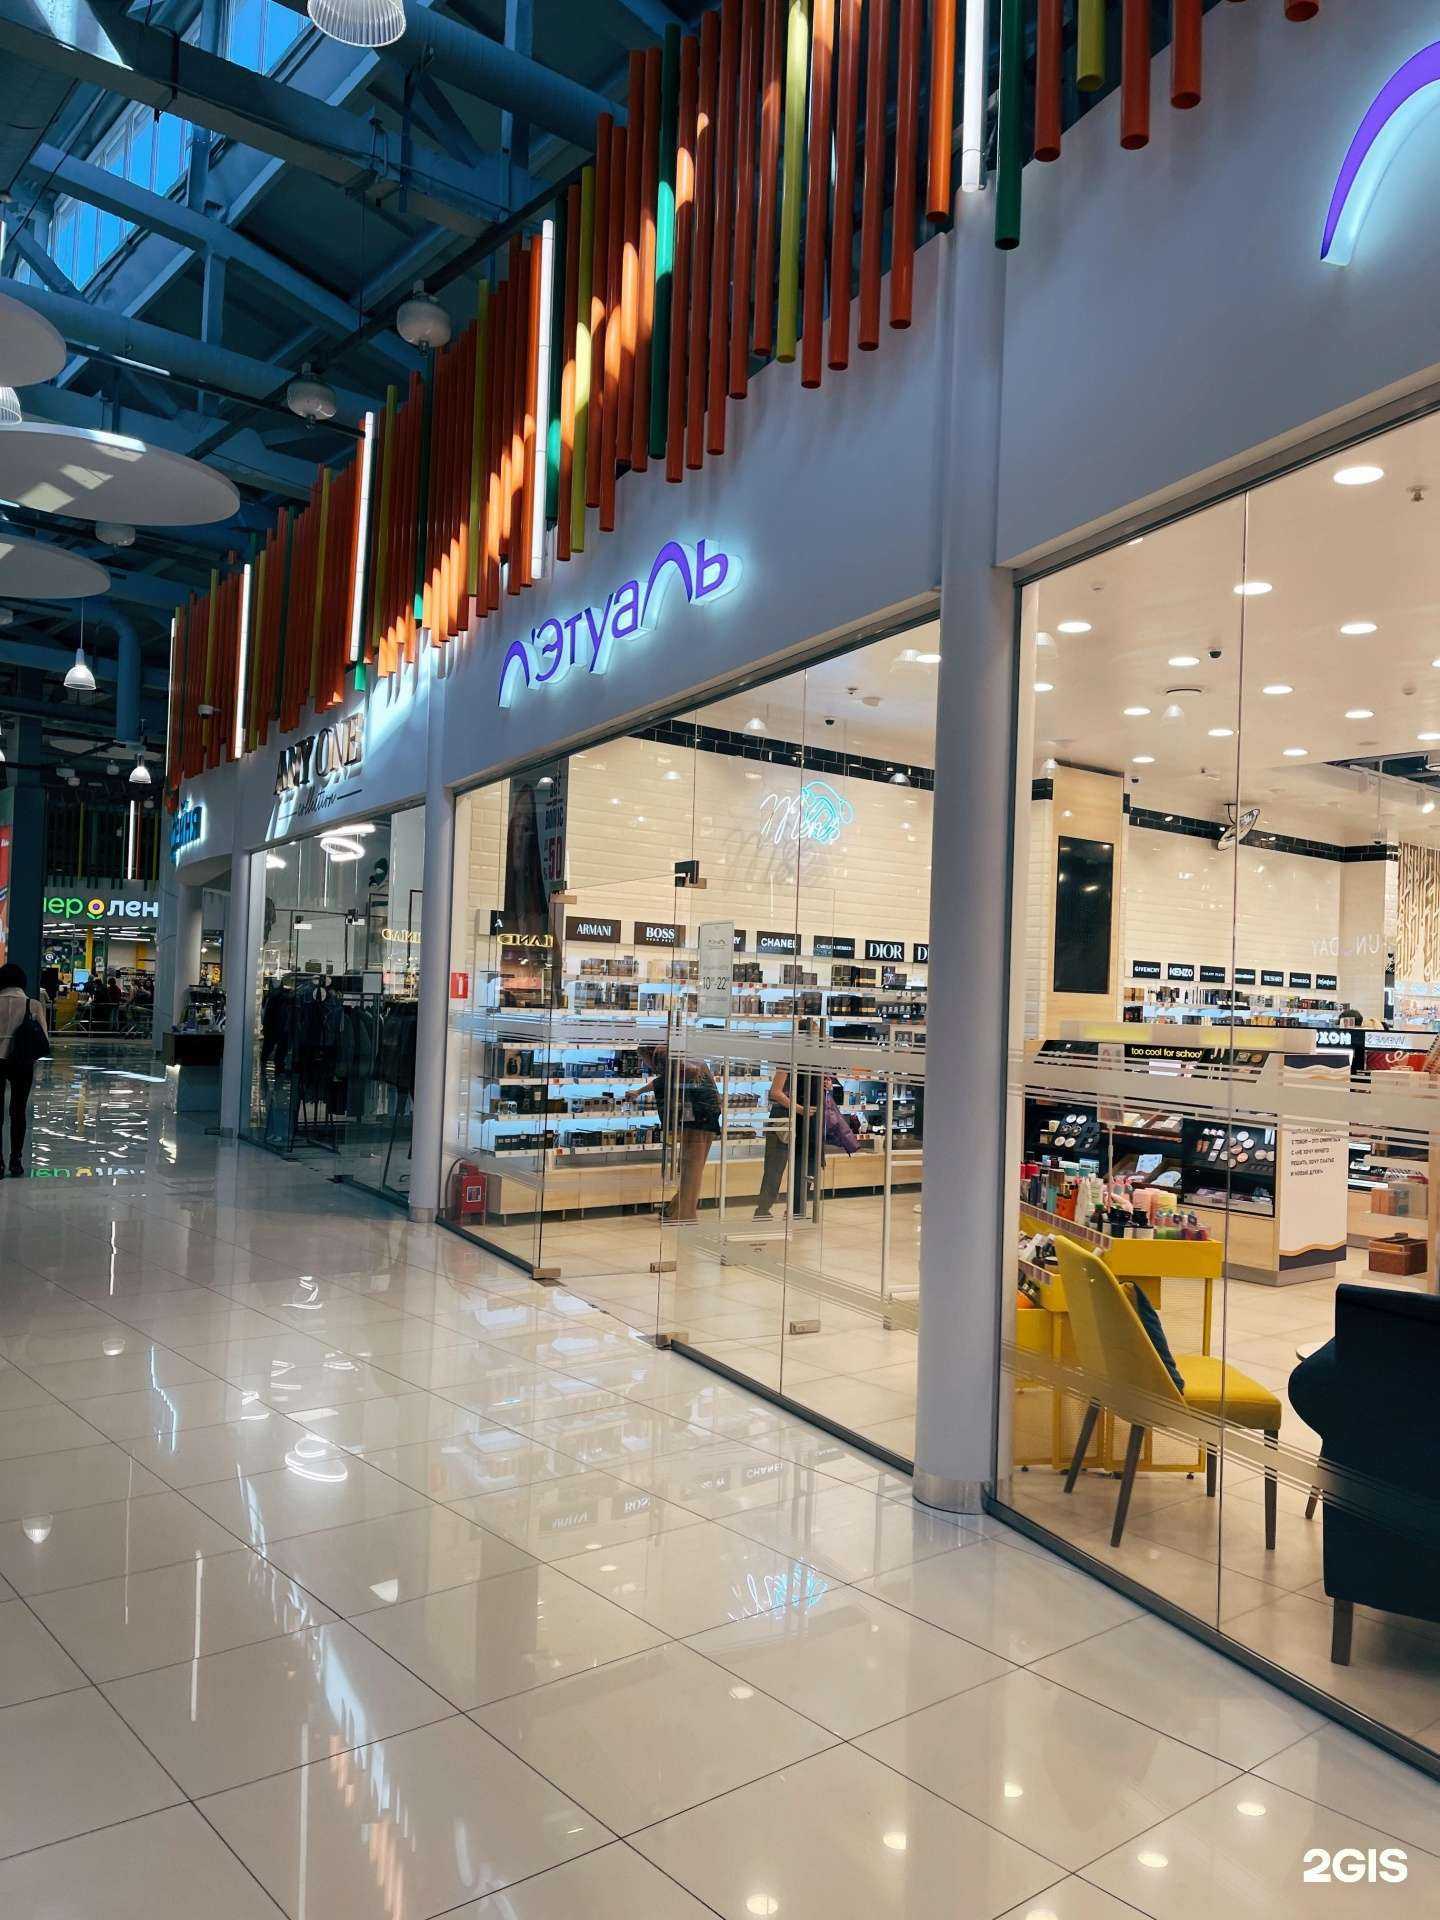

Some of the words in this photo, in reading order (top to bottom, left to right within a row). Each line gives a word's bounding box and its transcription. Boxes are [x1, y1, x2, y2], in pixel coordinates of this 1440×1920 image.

[576, 923, 612, 937] ARMANI
[645, 927, 675, 940] BOSS
[761, 937, 796, 949] CHANEL
[870, 943, 903, 959] DIOR
[1169, 966, 1194, 977] KENZO
[1131, 1047, 1144, 1056] too
[1145, 1048, 1162, 1057] cool
[1163, 1048, 1175, 1058] for
